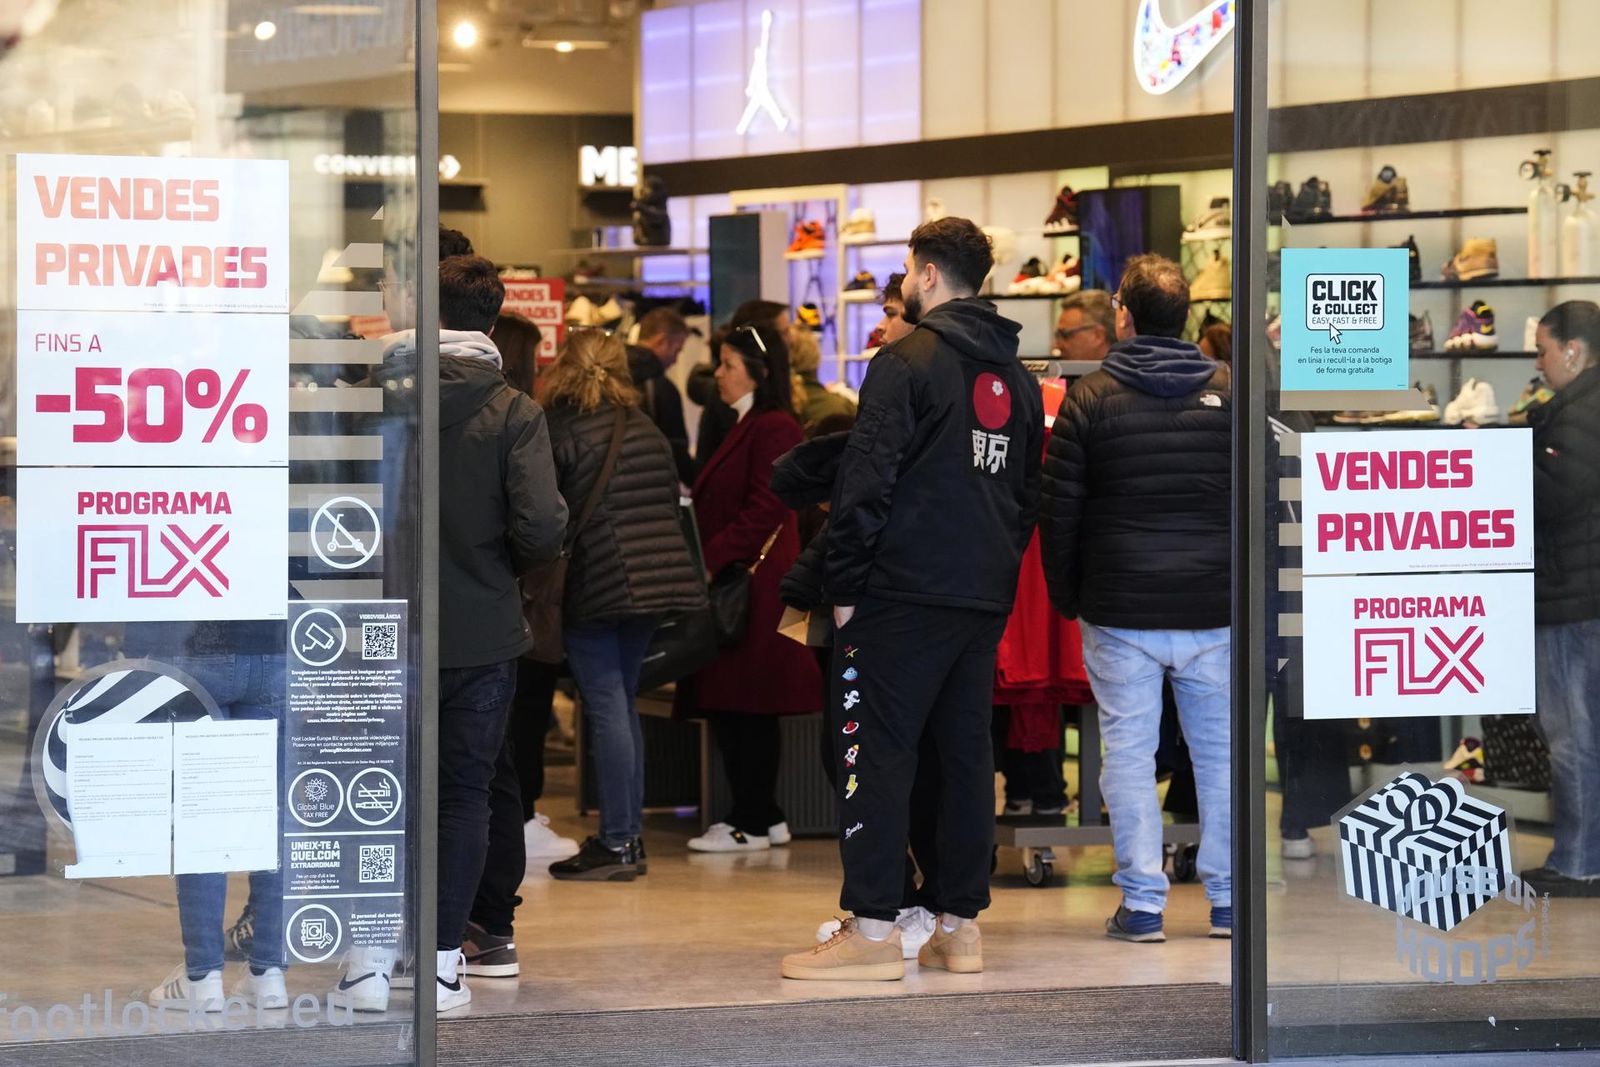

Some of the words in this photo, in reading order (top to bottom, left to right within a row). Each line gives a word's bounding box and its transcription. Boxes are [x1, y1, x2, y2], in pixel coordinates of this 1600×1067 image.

[34, 175, 219, 222] VENDES
[36, 242, 268, 289] PRIVADES
[1312, 280, 1377, 301] CLICK
[1312, 303, 1321, 315] &
[1325, 303, 1378, 315] COLLECT
[1333, 316, 1350, 325] FAST
[1351, 316, 1357, 325] &
[1359, 316, 1377, 325] FREE
[36, 333, 81, 353] FINS
[88, 333, 102, 353] A
[1310, 346, 1322, 354] Fes
[1324, 346, 1330, 354] la
[1348, 346, 1380, 354] comanda
[1316, 366, 1325, 374] de
[1326, 366, 1347, 374] forma
[1363, 356, 1369, 364] la
[1371, 356, 1393, 365] botiga
[35, 367, 269, 444] -50%
[972, 429, 1011, 474] 東京
[1316, 449, 1474, 492] VENDES
[77, 490, 232, 515] PROGRAMA
[1317, 508, 1516, 553] PRIVADES
[76, 523, 230, 599] FLX
[1353, 595, 1486, 620] PROGRAMA
[1353, 624, 1485, 698] FLX
[297, 803, 318, 811] Global
[320, 802, 335, 811] Blue
[291, 841, 332, 851] UNEIX-TE
[333, 840, 341, 850] A
[291, 850, 341, 861] QUELCOM
[290, 861, 341, 869] EXTRAORDINARI
